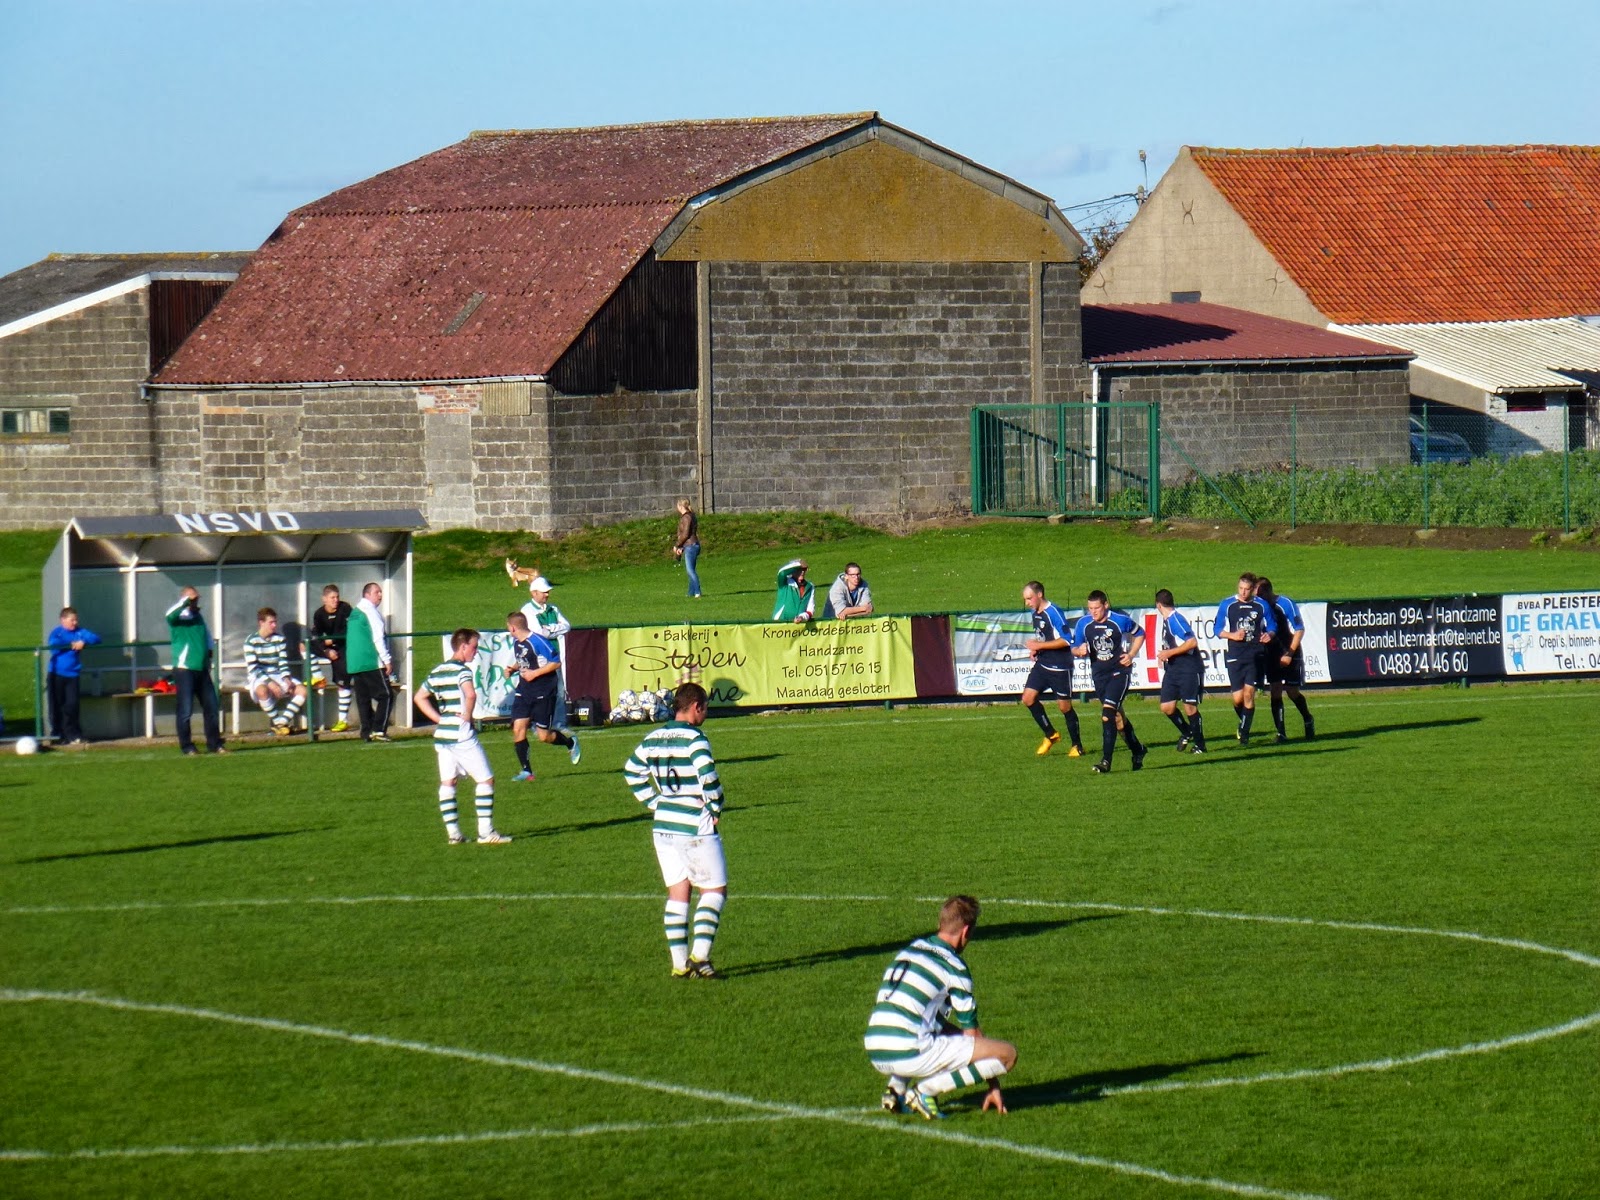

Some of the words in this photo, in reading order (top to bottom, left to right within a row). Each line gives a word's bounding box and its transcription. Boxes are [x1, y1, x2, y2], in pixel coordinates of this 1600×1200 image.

[174, 511, 300, 533] NSVD
[1517, 601, 1541, 610] BVBA
[1332, 608, 1397, 628] Staatsbaan
[1399, 607, 1425, 625] 99A
[1436, 605, 1497, 624] Handzame
[1506, 614, 1531, 632] DE
[881, 620, 898, 633] 80
[663, 629, 710, 643] Bakkerij
[624, 645, 746, 671] Steven
[799, 644, 864, 657] Handzame
[782, 665, 801, 678] Tel.
[805, 664, 828, 678] 051
[831, 662, 847, 676] 57
[851, 662, 865, 675] 16
[869, 661, 882, 674] 15
[1378, 652, 1412, 675] 0488
[1433, 651, 1450, 673] 46
[1452, 650, 1469, 673] 60
[777, 684, 834, 699] Maandag
[838, 683, 891, 698] gesloten
